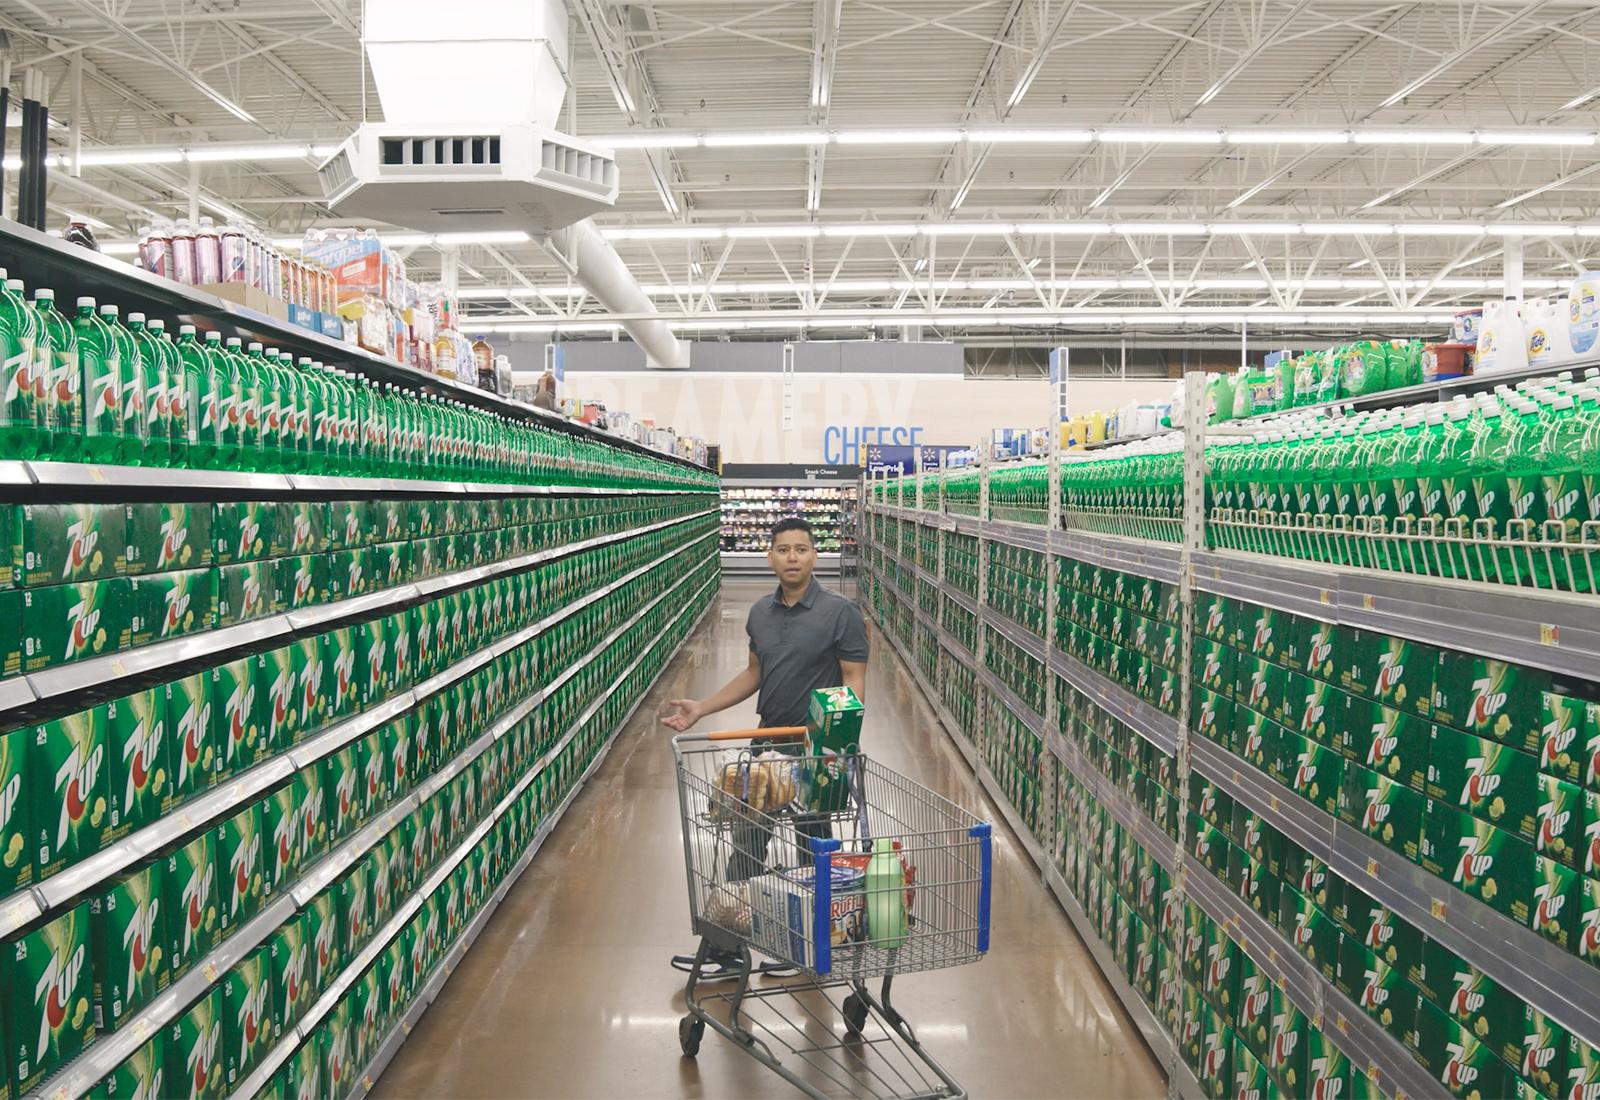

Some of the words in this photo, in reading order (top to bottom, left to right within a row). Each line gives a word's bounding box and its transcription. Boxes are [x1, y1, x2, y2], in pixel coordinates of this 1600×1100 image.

[1529, 335, 1546, 349] Tide
[108, 703, 116, 713] 24
[37, 726, 47, 738] 24
[107, 893, 115, 904] 24
[16, 941, 27, 954] 24
